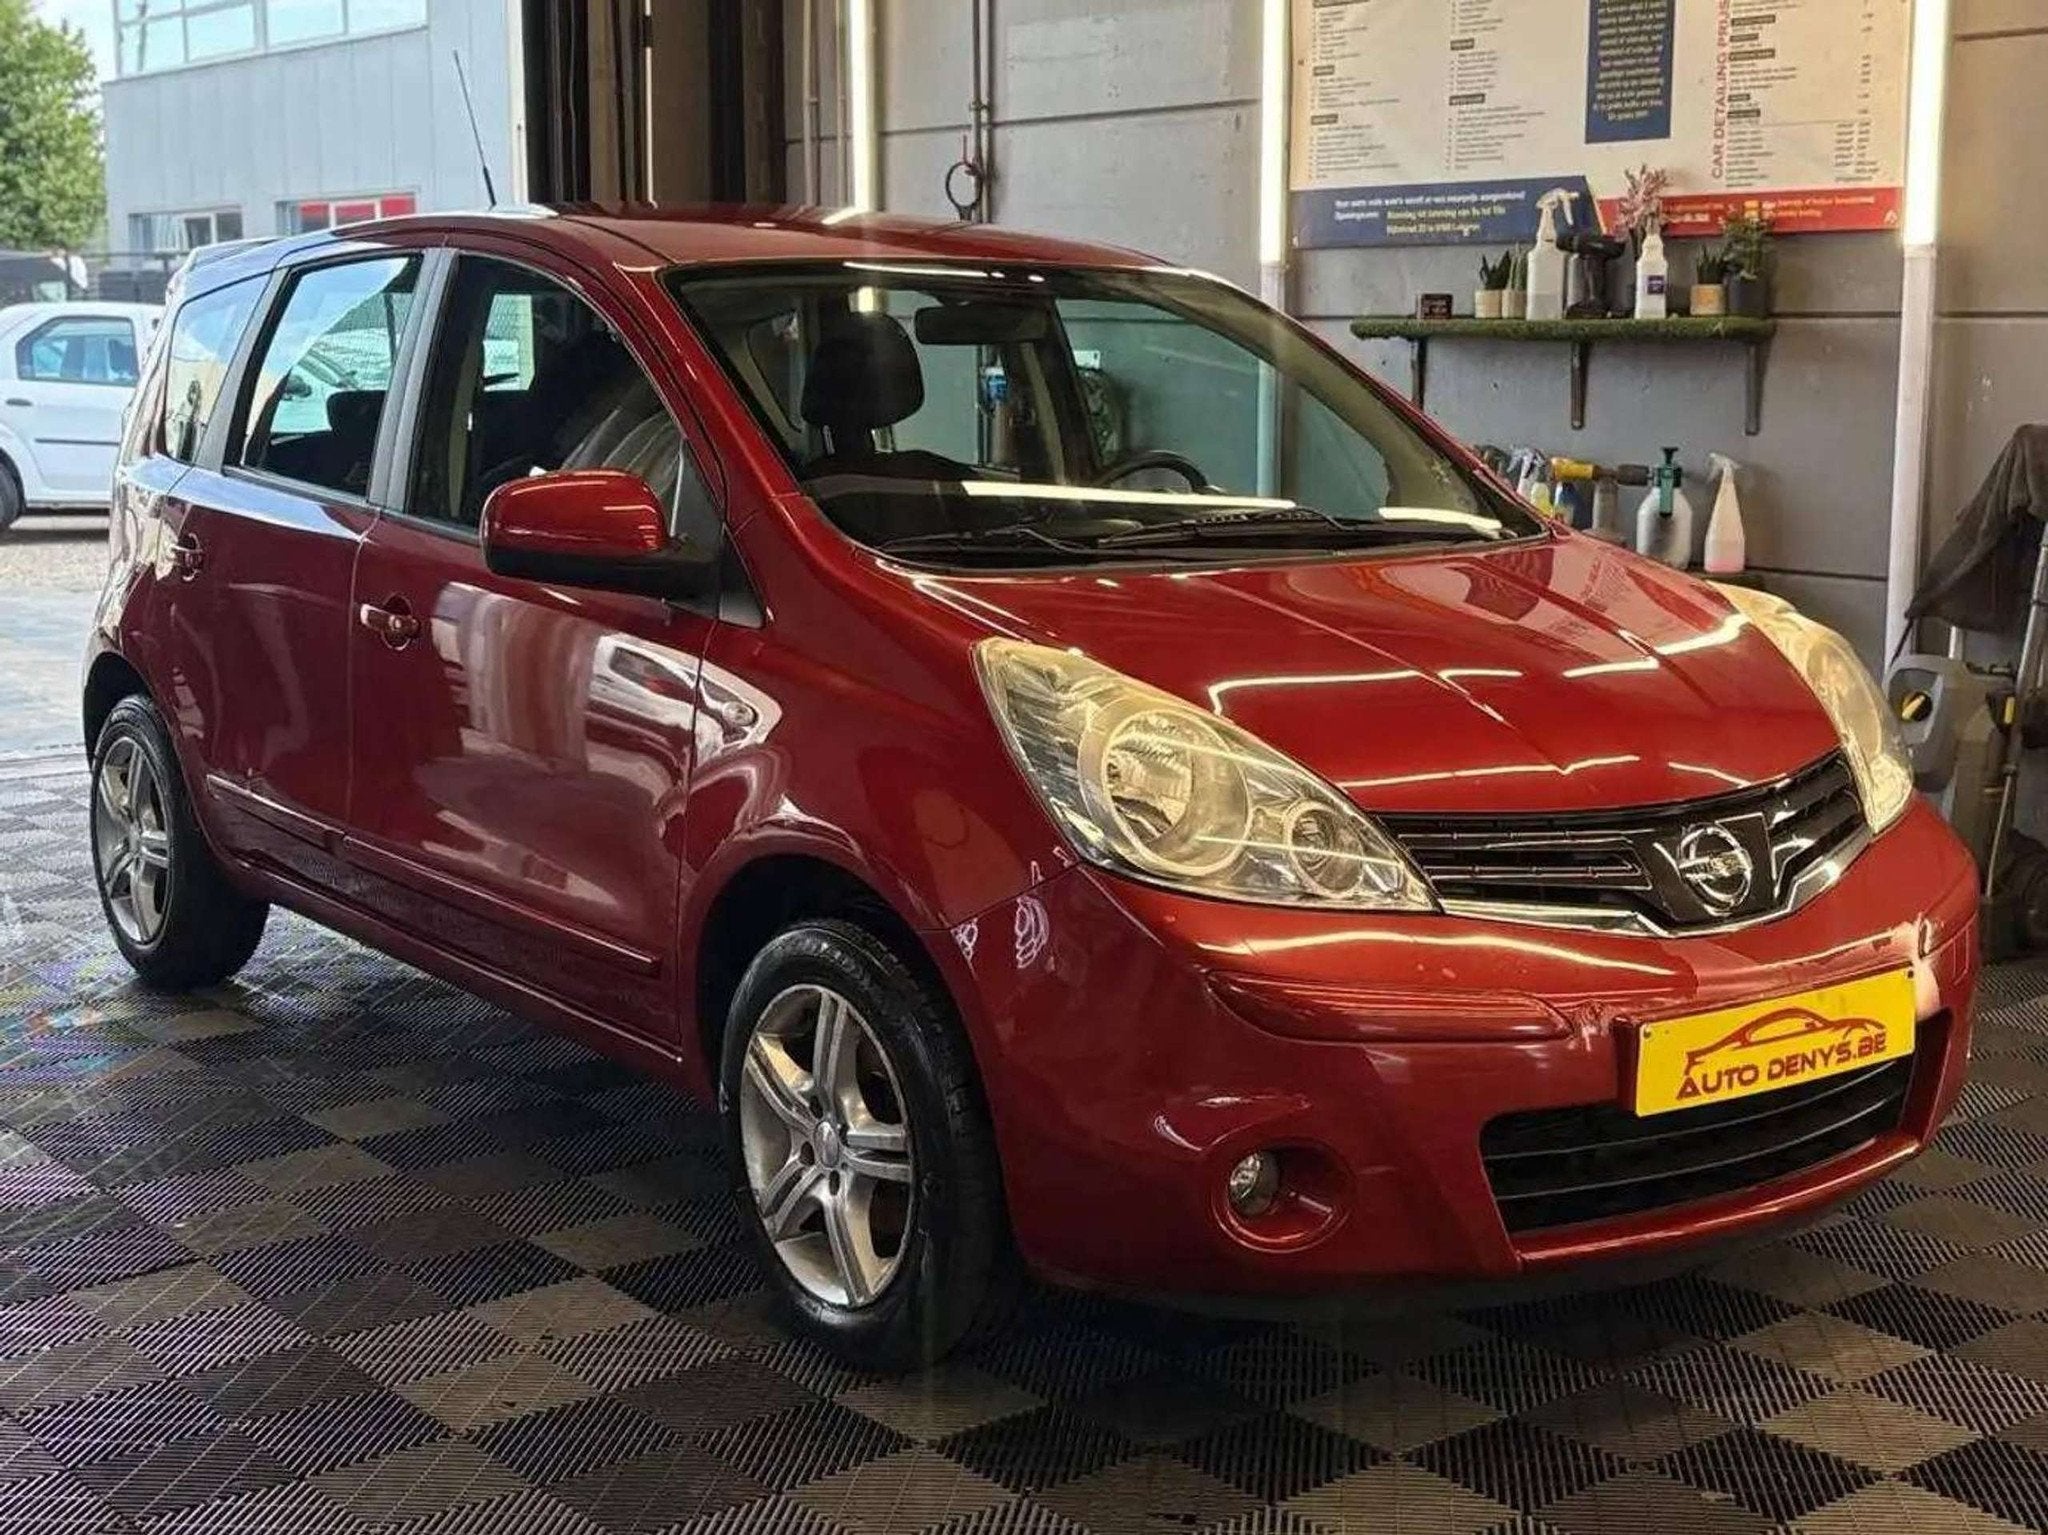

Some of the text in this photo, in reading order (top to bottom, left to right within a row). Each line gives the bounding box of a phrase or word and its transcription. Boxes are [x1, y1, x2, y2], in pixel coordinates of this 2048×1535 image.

[1713, 52, 1728, 140] DETAILING
[1711, 143, 1724, 179] CAR
[1677, 1032, 1887, 1100] AUTO DENYS.BE
